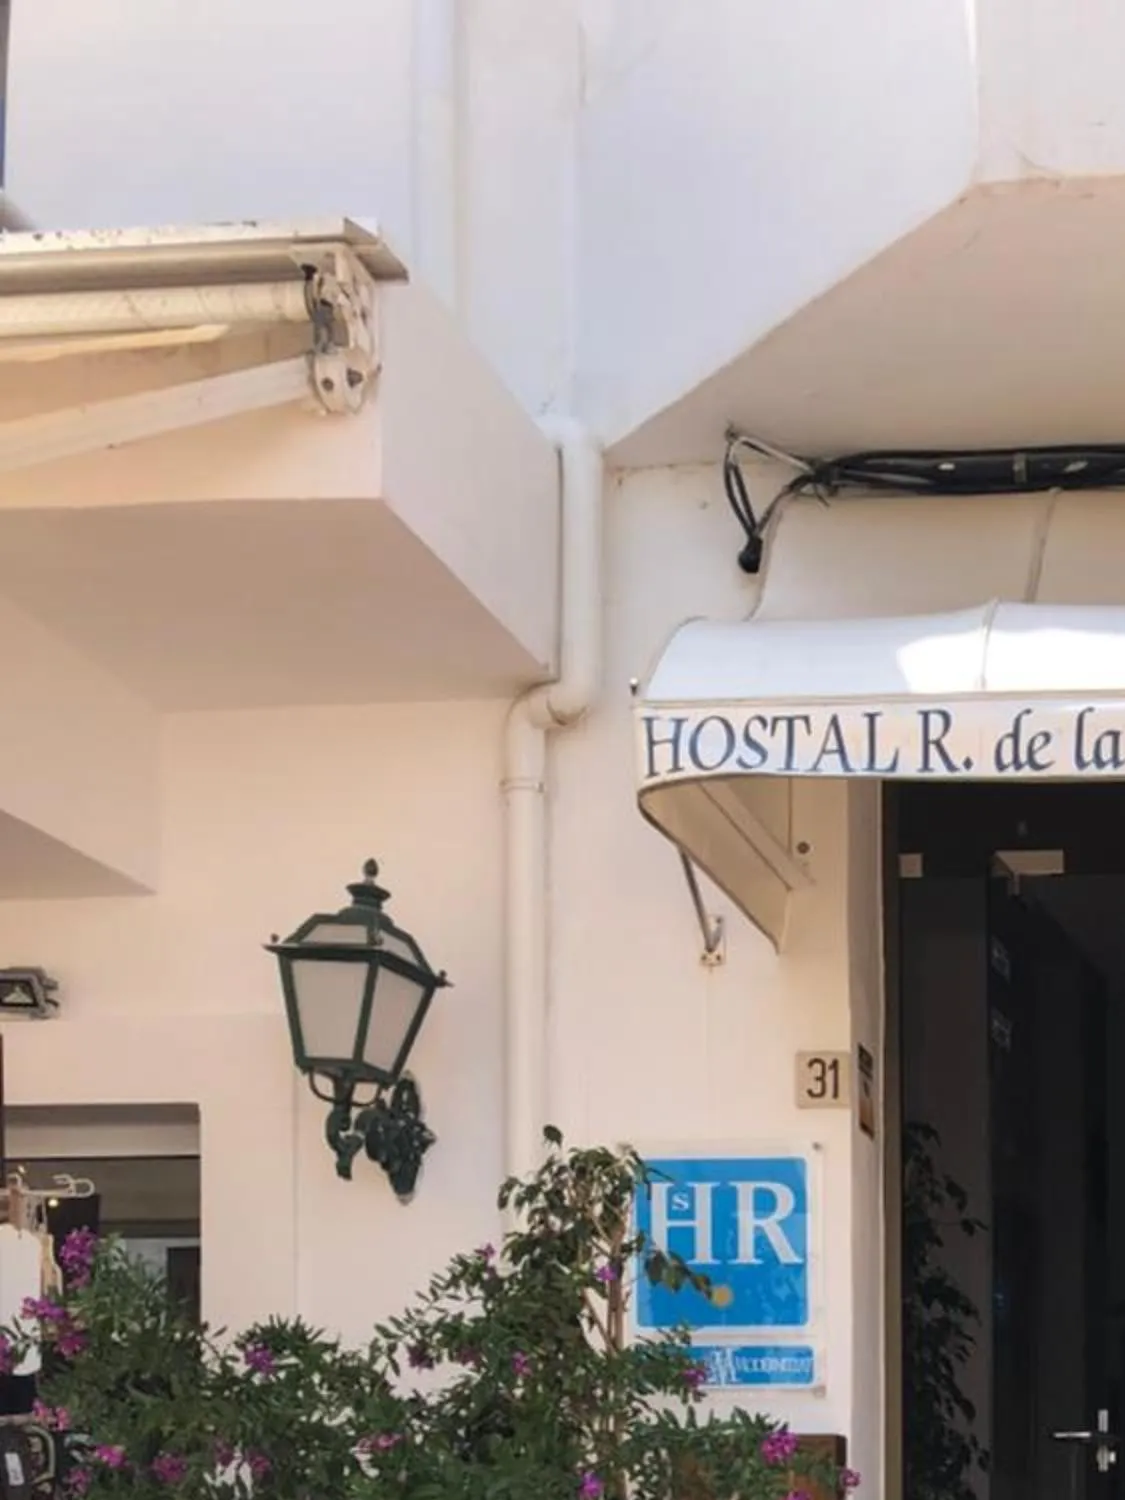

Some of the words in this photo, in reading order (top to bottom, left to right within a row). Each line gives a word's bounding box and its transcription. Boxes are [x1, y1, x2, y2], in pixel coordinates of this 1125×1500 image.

[640, 711, 899, 777] HOSTAL
[916, 708, 974, 773] R.
[994, 708, 1055, 772] de
[806, 1058, 840, 1099] 31
